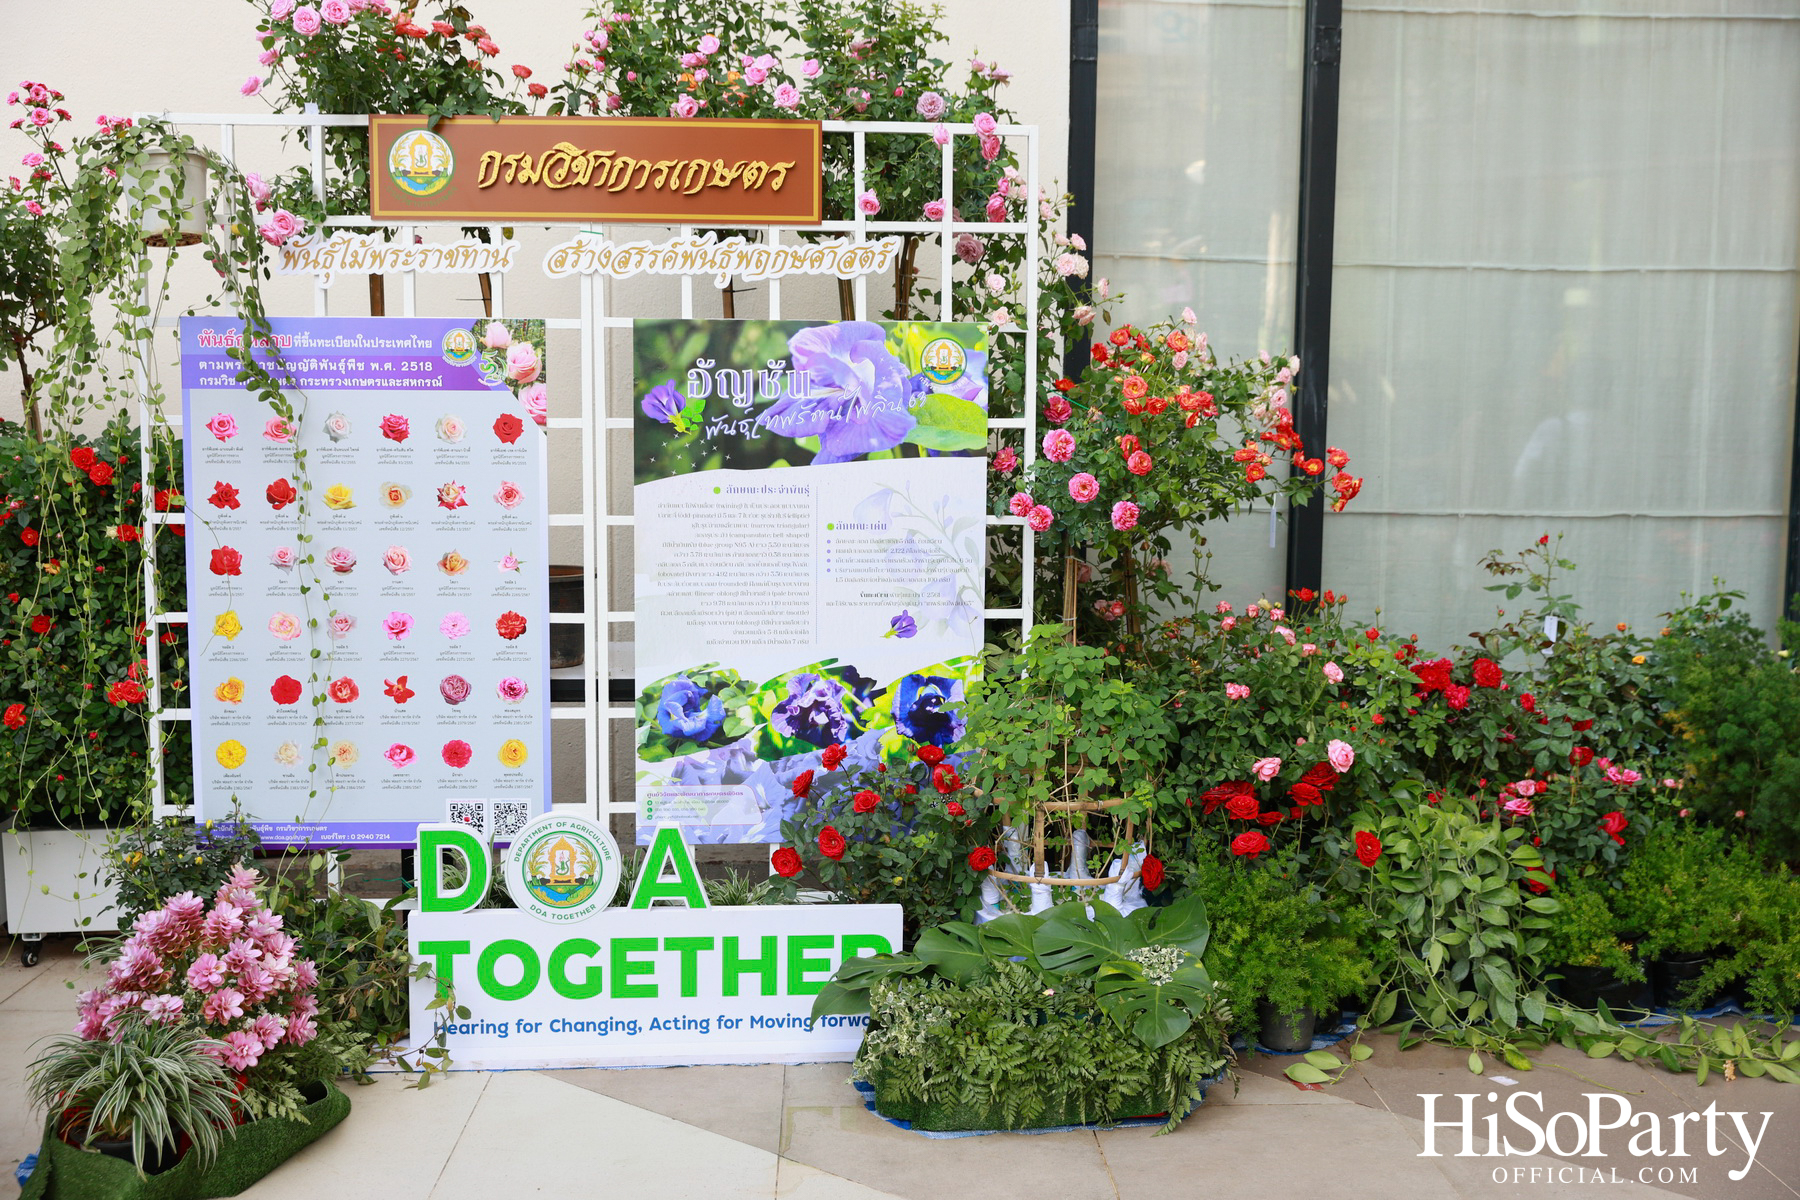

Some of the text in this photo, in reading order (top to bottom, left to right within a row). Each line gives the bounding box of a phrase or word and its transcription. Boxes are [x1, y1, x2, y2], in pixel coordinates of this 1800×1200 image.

[478, 141, 797, 195] กรมวิชาการเกษตร
[281, 236, 898, 284] พันธุ์ไม้พระราชทาน สร้างสรรค์พันธุ์พฤกษศาสตร์
[293, 333, 433, 348] ที่ขึ้นทะเบียนในประเทศไทย
[370, 361, 396, 372] พ.ศ.
[401, 361, 433, 372] 2518
[299, 375, 443, 387] กระทรวงเกษตรและสหกรณ์
[687, 358, 813, 407] อัญชัน
[514, 823, 553, 862] DEPARTMENT
[570, 823, 612, 861] AGRICULTURE
[530, 903, 597, 920] DOA TOGETHER
[434, 1019, 509, 1038] Hearing
[516, 1018, 543, 1034] for
[550, 1017, 643, 1036] Changing,
[649, 1014, 711, 1034] Acting
[717, 1015, 743, 1029] for
[750, 1013, 814, 1032] Moving
